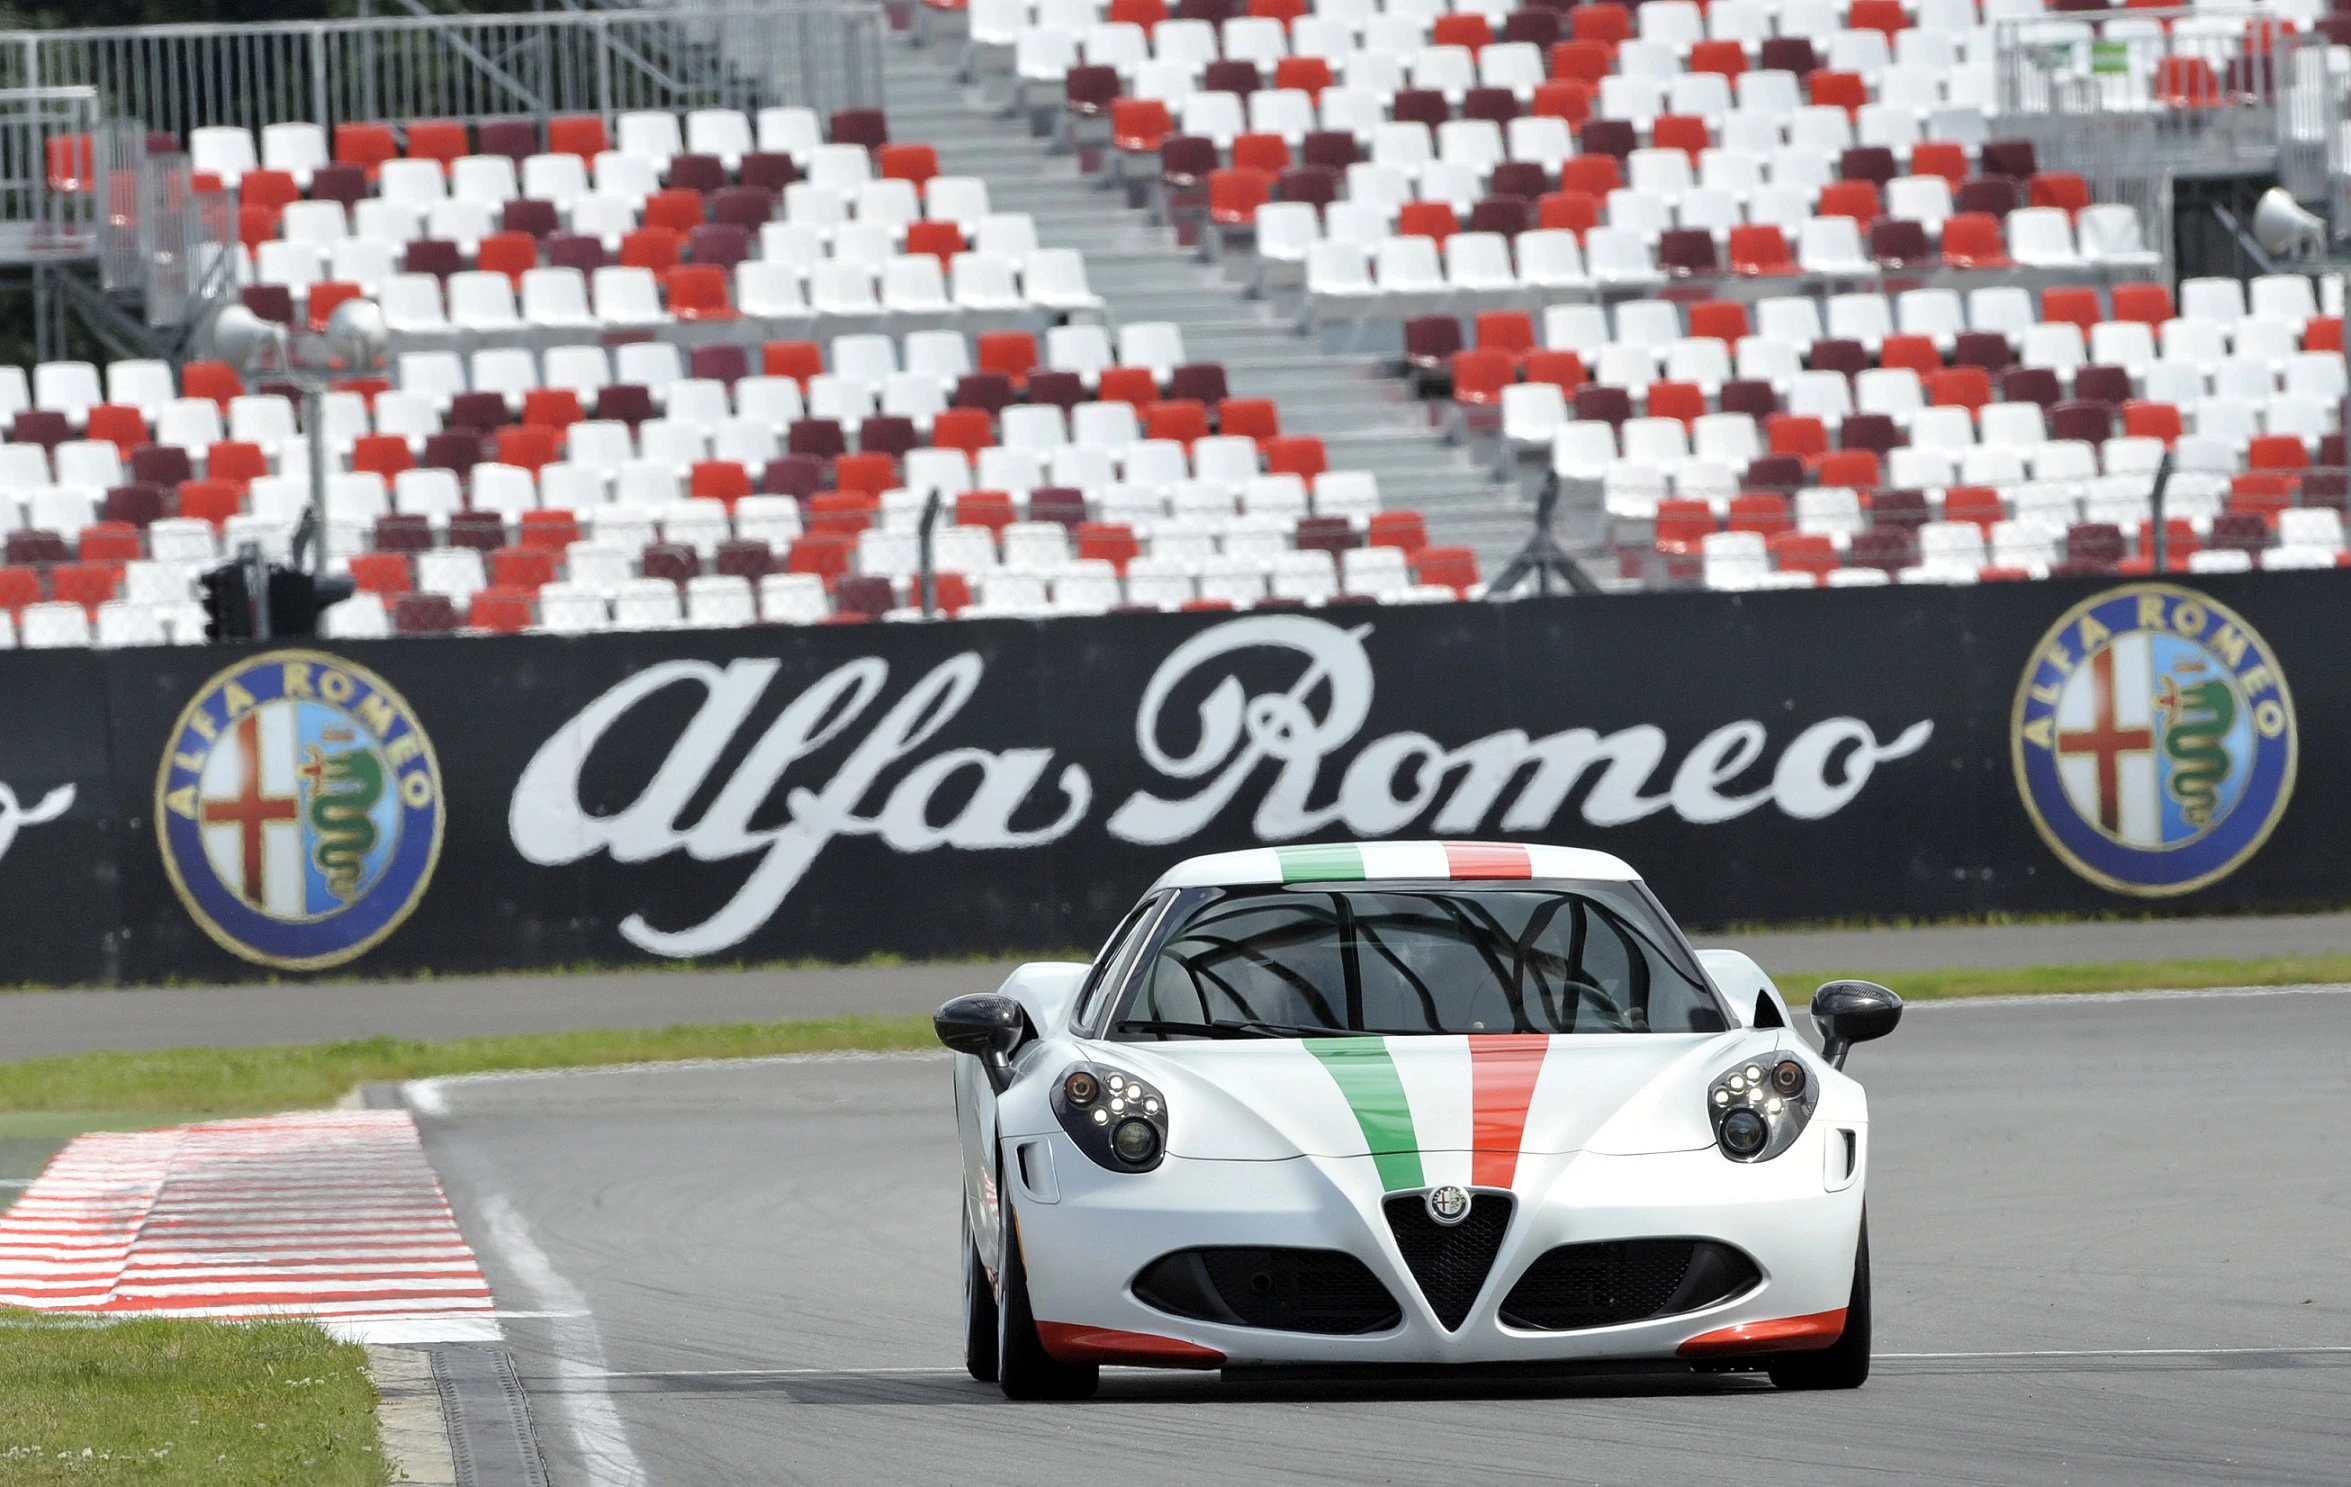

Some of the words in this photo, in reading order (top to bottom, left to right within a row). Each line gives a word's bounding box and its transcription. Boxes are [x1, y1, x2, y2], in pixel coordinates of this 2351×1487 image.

[166, 681, 253, 820] ALFA
[283, 662, 433, 810] ROMEO
[2022, 612, 2111, 750] ALFA
[2137, 593, 2286, 740] ROMEO
[509, 653, 1091, 957] Alfa
[1107, 615, 1933, 844] Romeo
